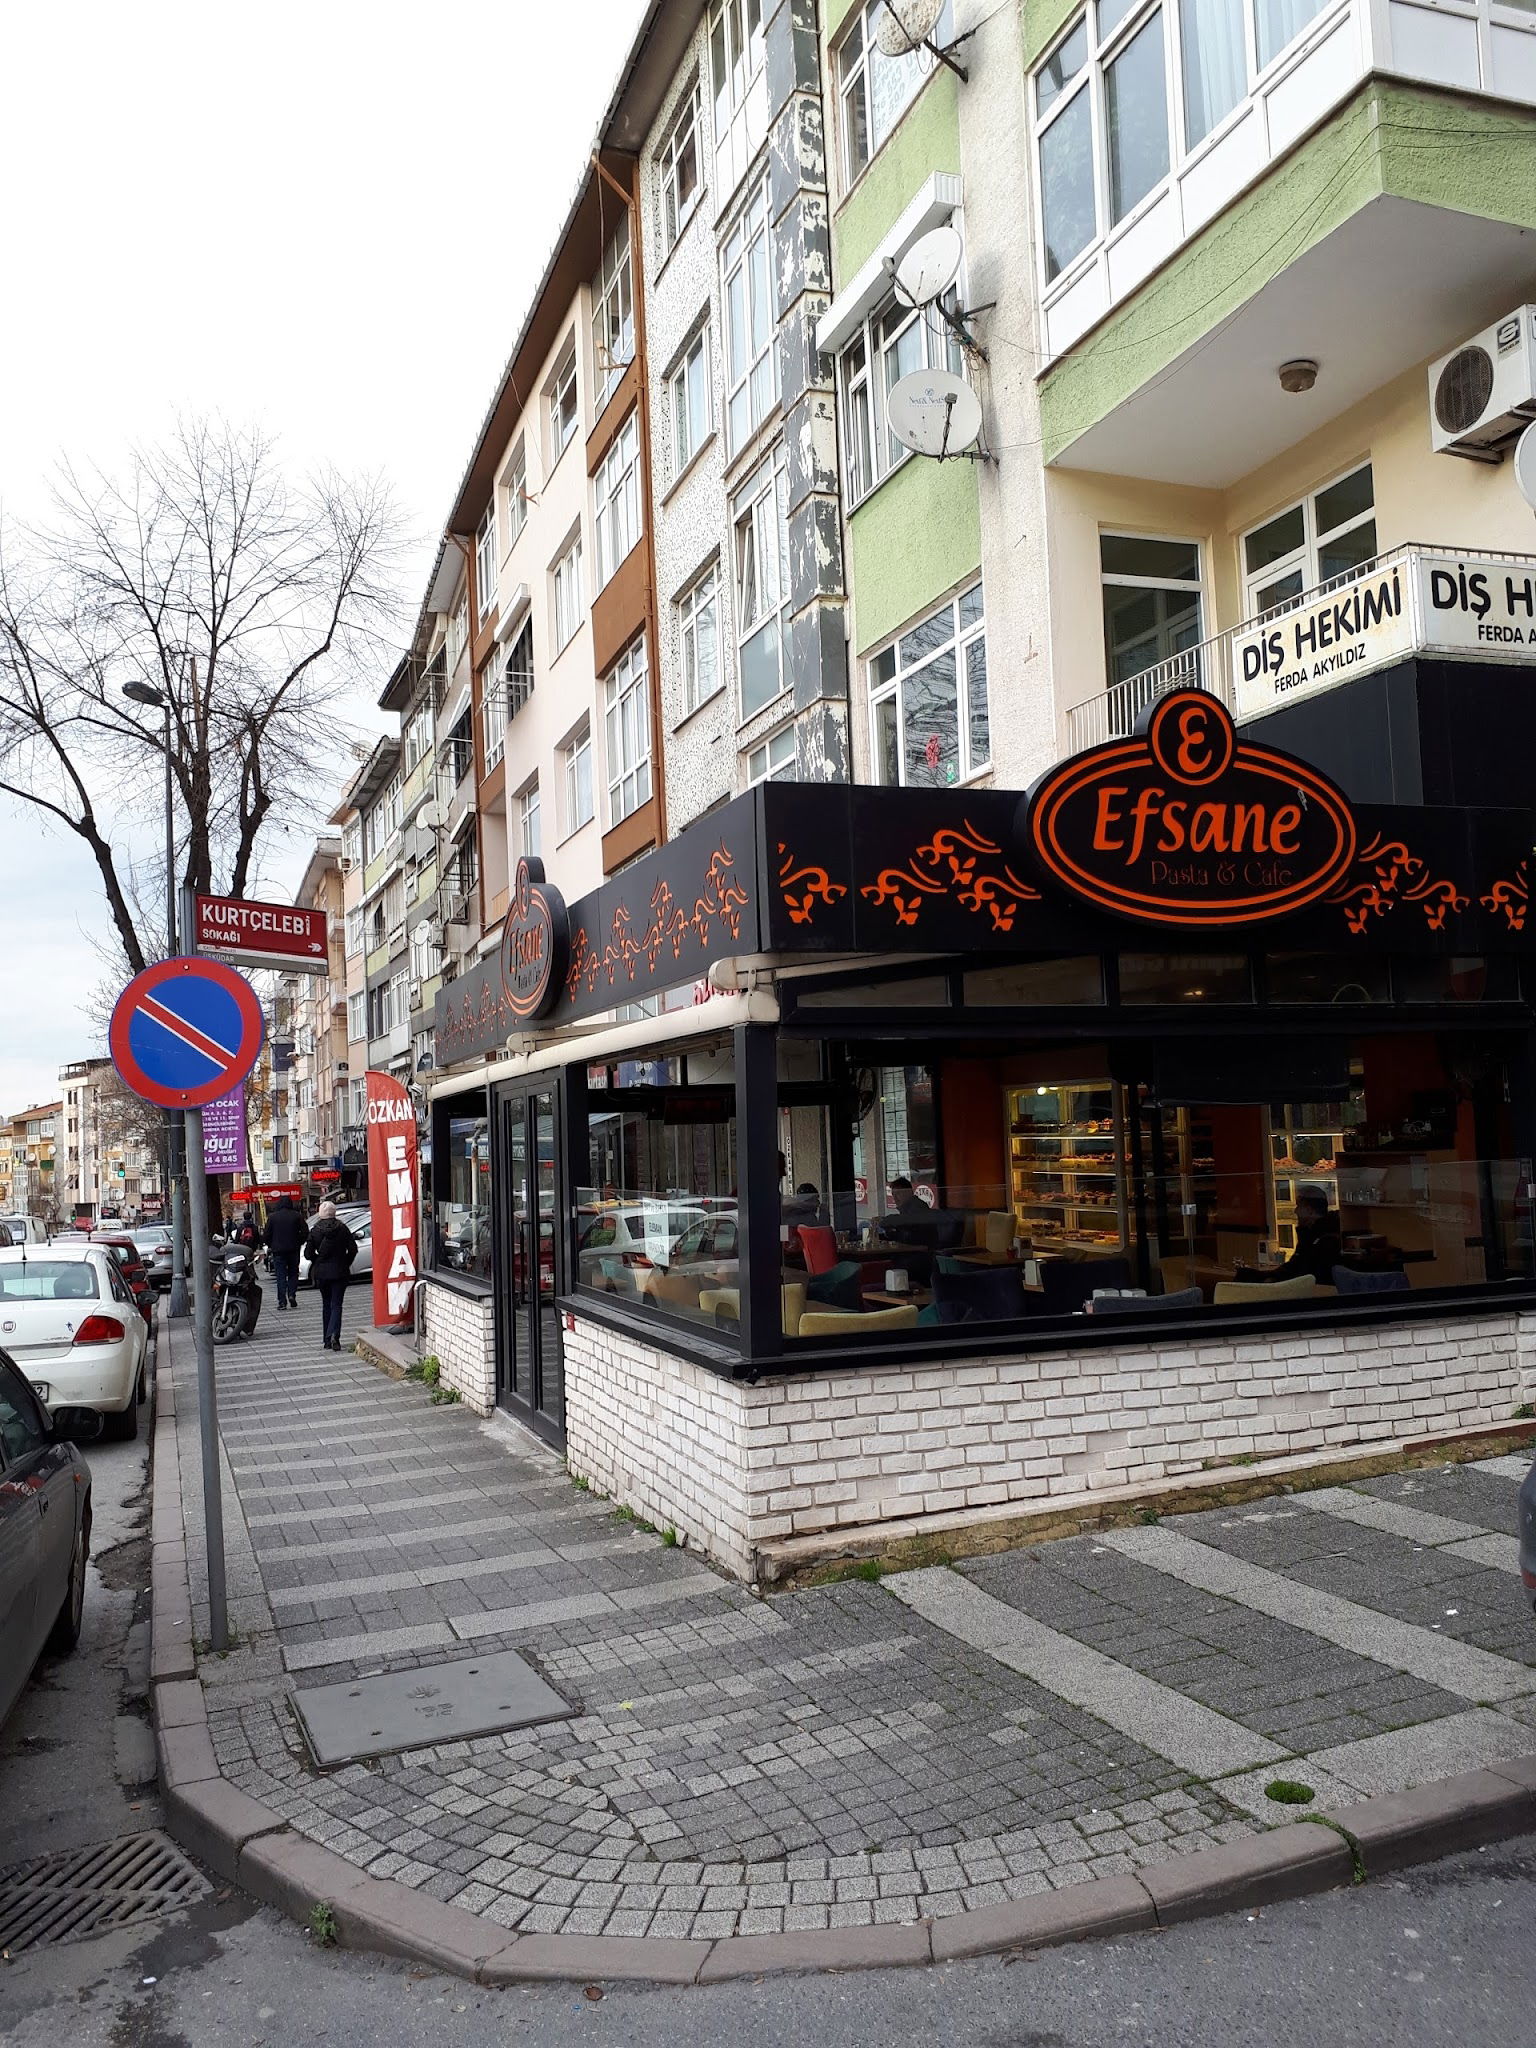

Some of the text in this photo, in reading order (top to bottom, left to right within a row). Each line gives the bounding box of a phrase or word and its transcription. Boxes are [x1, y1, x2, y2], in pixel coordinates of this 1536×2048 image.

[1430, 563, 1491, 621] DİŞ
[1242, 567, 1401, 682] DİŞ HEKİMİ
[1478, 624, 1525, 645] FERDA
[1273, 643, 1367, 695] FERDA AKYILDIZ
[1093, 787, 1301, 866] Efsane
[1150, 860, 1209, 886] Pasta
[1243, 859, 1293, 886] Cafe
[202, 903, 311, 937] KURTÇELEBİ
[202, 928, 241, 943] SOKAĞI
[216, 1100, 240, 1108] OCAK
[368, 1097, 414, 1124] ÖZKAN
[222, 1154, 238, 1163] 845
[387, 1135, 416, 1316] EMLAK
